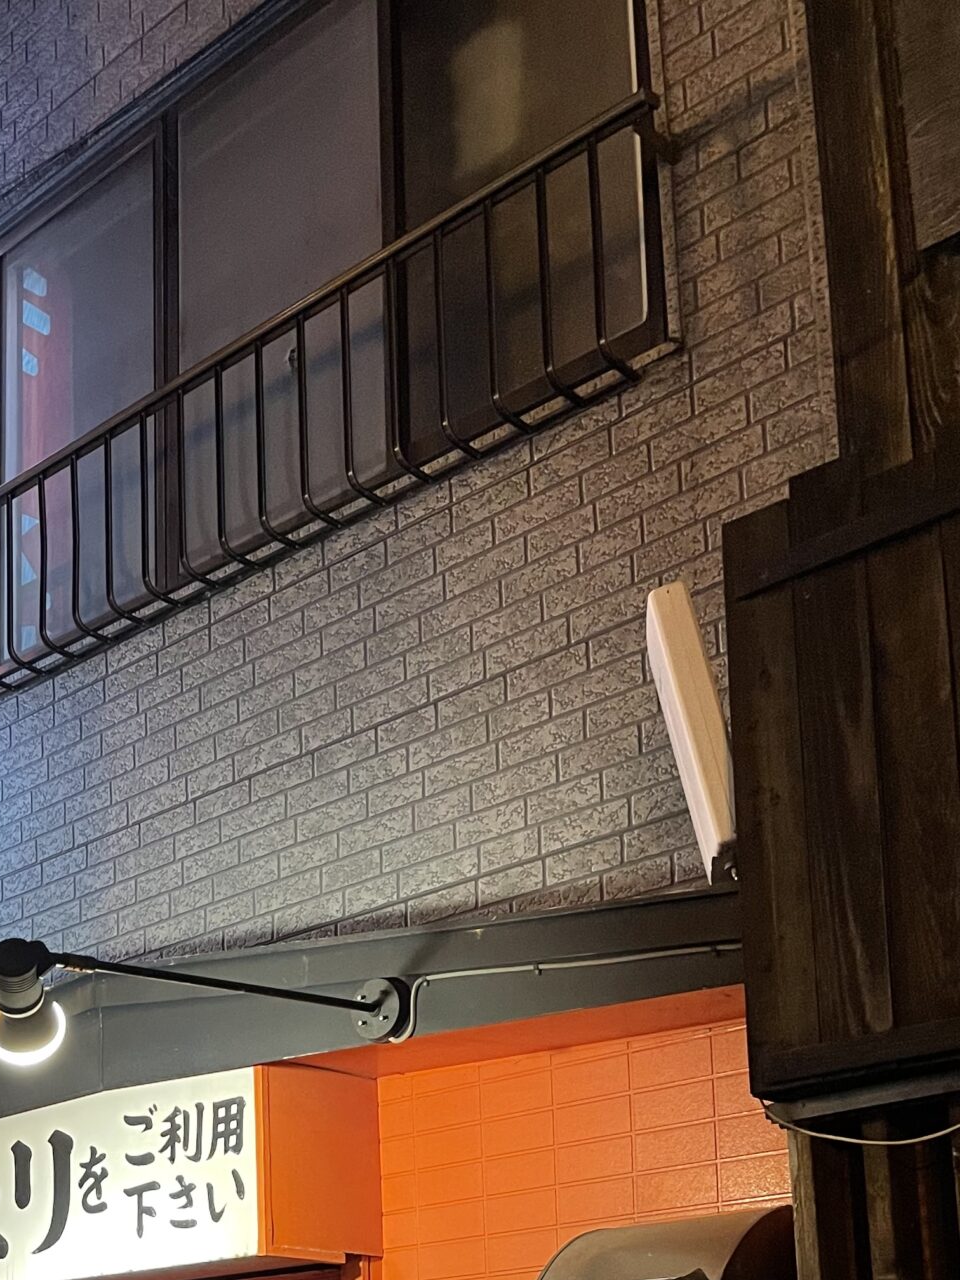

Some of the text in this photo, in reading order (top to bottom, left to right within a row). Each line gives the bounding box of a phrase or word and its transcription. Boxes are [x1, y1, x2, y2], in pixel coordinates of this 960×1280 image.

[123, 1096, 246, 1166] ご利用
[123, 1170, 245, 1239] 下さい
